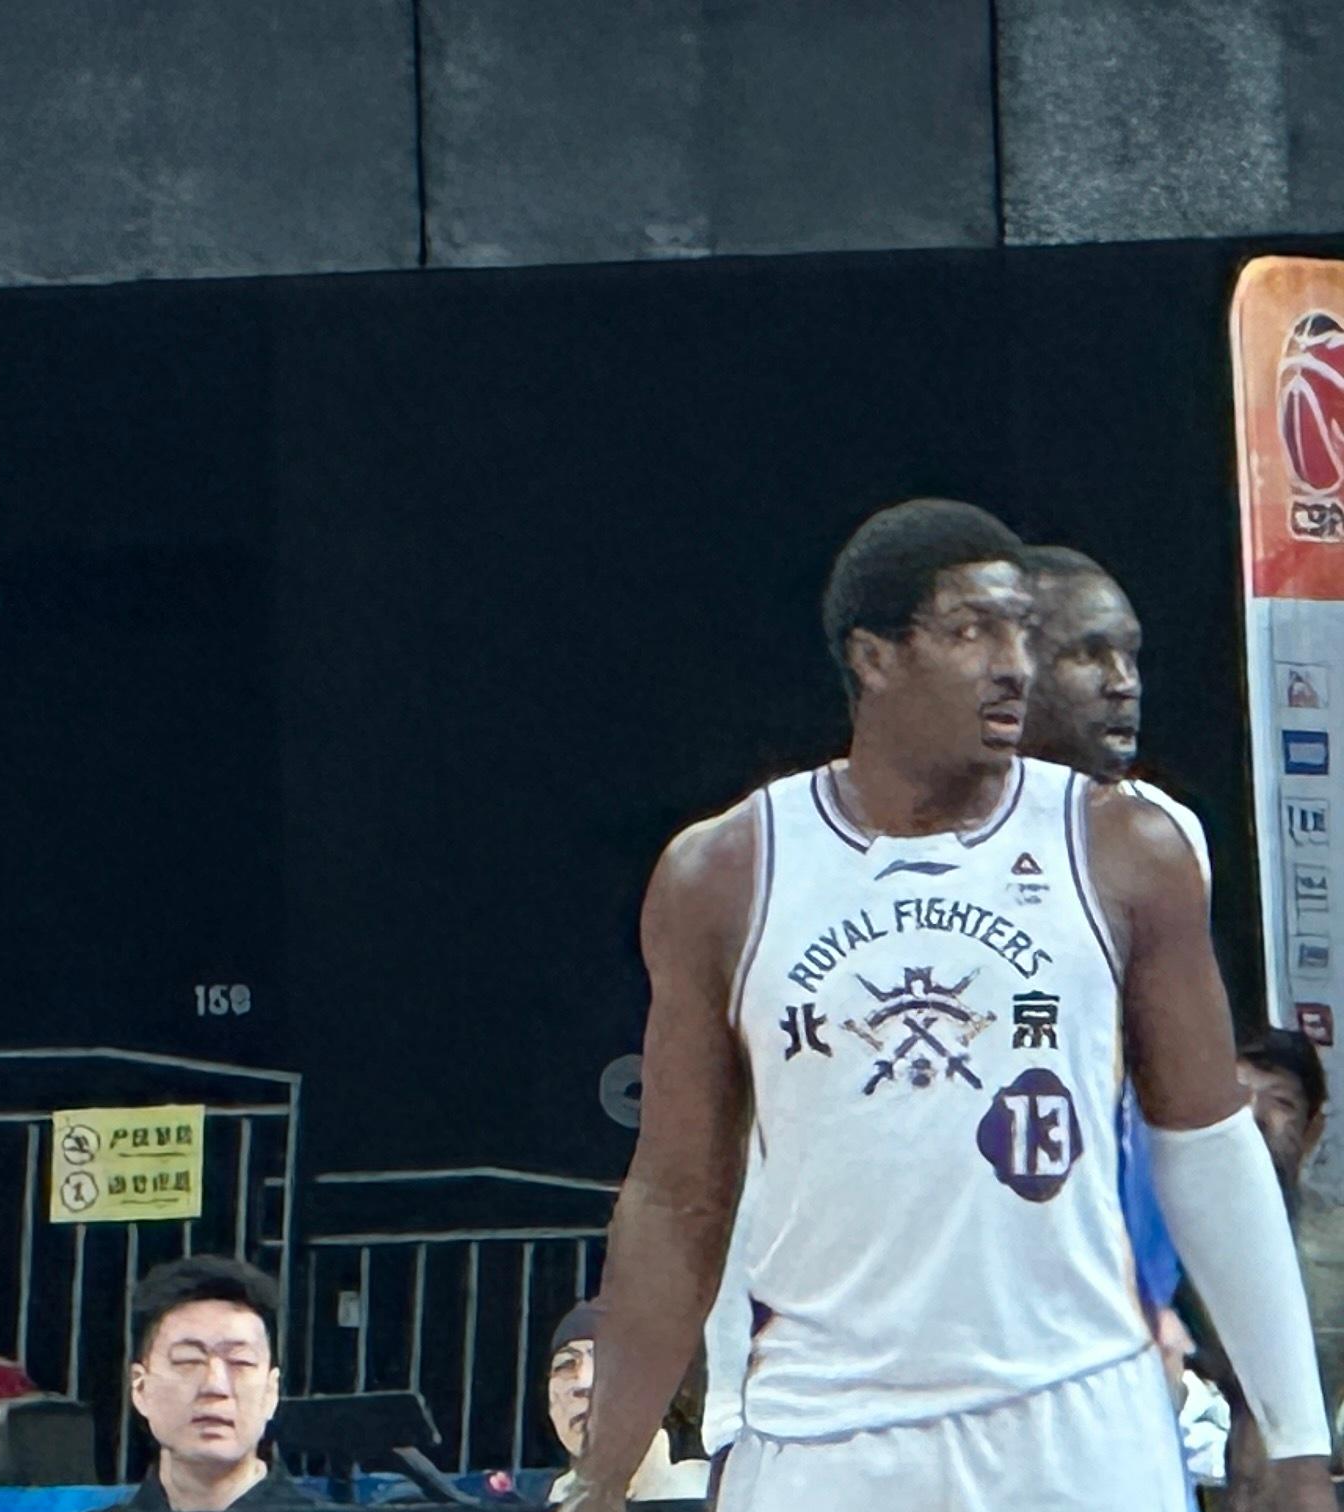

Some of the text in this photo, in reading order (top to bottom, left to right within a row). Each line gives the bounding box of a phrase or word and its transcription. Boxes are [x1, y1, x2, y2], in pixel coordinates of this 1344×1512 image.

[787, 897, 1053, 994] ROYAL FIGHTERS
[778, 990, 1061, 1061] 北 京
[1004, 1094, 1073, 1177] 13
